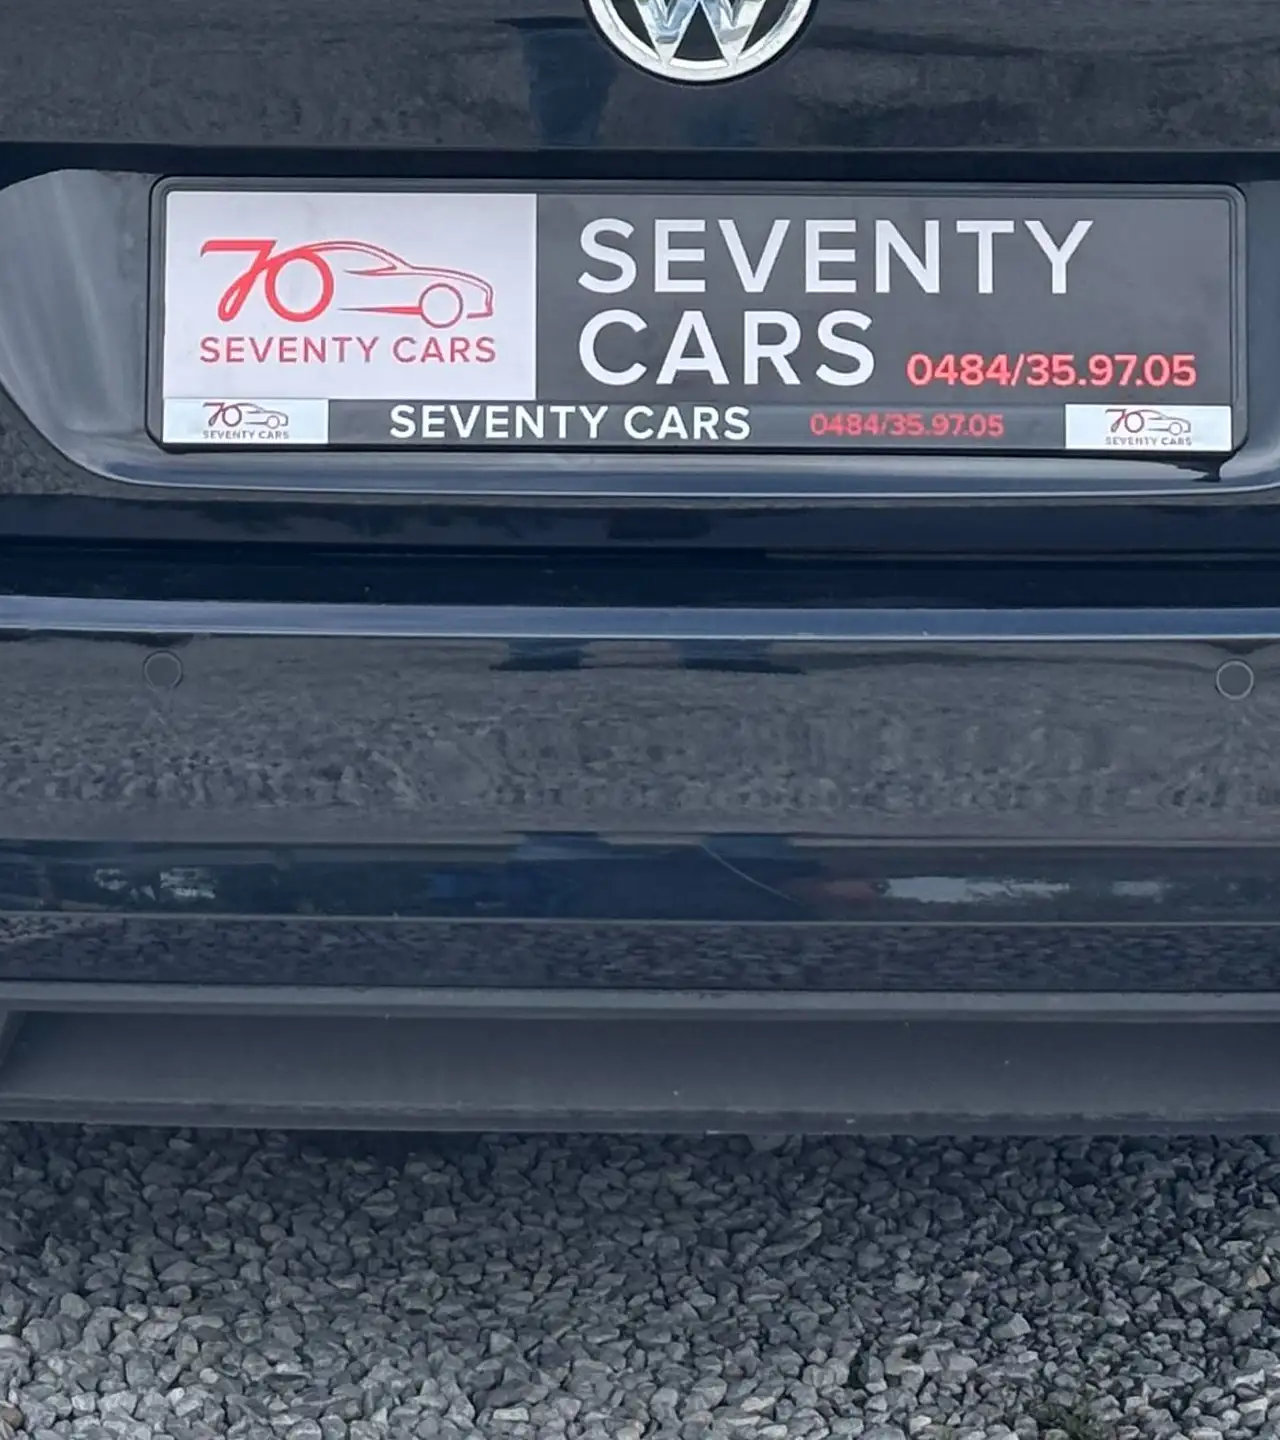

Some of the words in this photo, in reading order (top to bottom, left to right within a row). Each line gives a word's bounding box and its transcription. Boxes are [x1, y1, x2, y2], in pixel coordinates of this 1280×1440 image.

[577, 217, 1095, 295] SEVENTY
[199, 239, 335, 323] 70
[199, 335, 380, 364] SEVENTY
[392, 335, 498, 364] CARS
[578, 308, 876, 387] CARS
[905, 351, 1198, 389] 0484/35.97.05
[202, 401, 243, 428] 70
[390, 403, 609, 440] SEVENTY
[623, 404, 752, 441] CARS
[808, 411, 1006, 439] 0484/35.97.05
[1104, 408, 1145, 434] 70
[202, 429, 256, 440] SEVENTY
[257, 429, 290, 441] CARS
